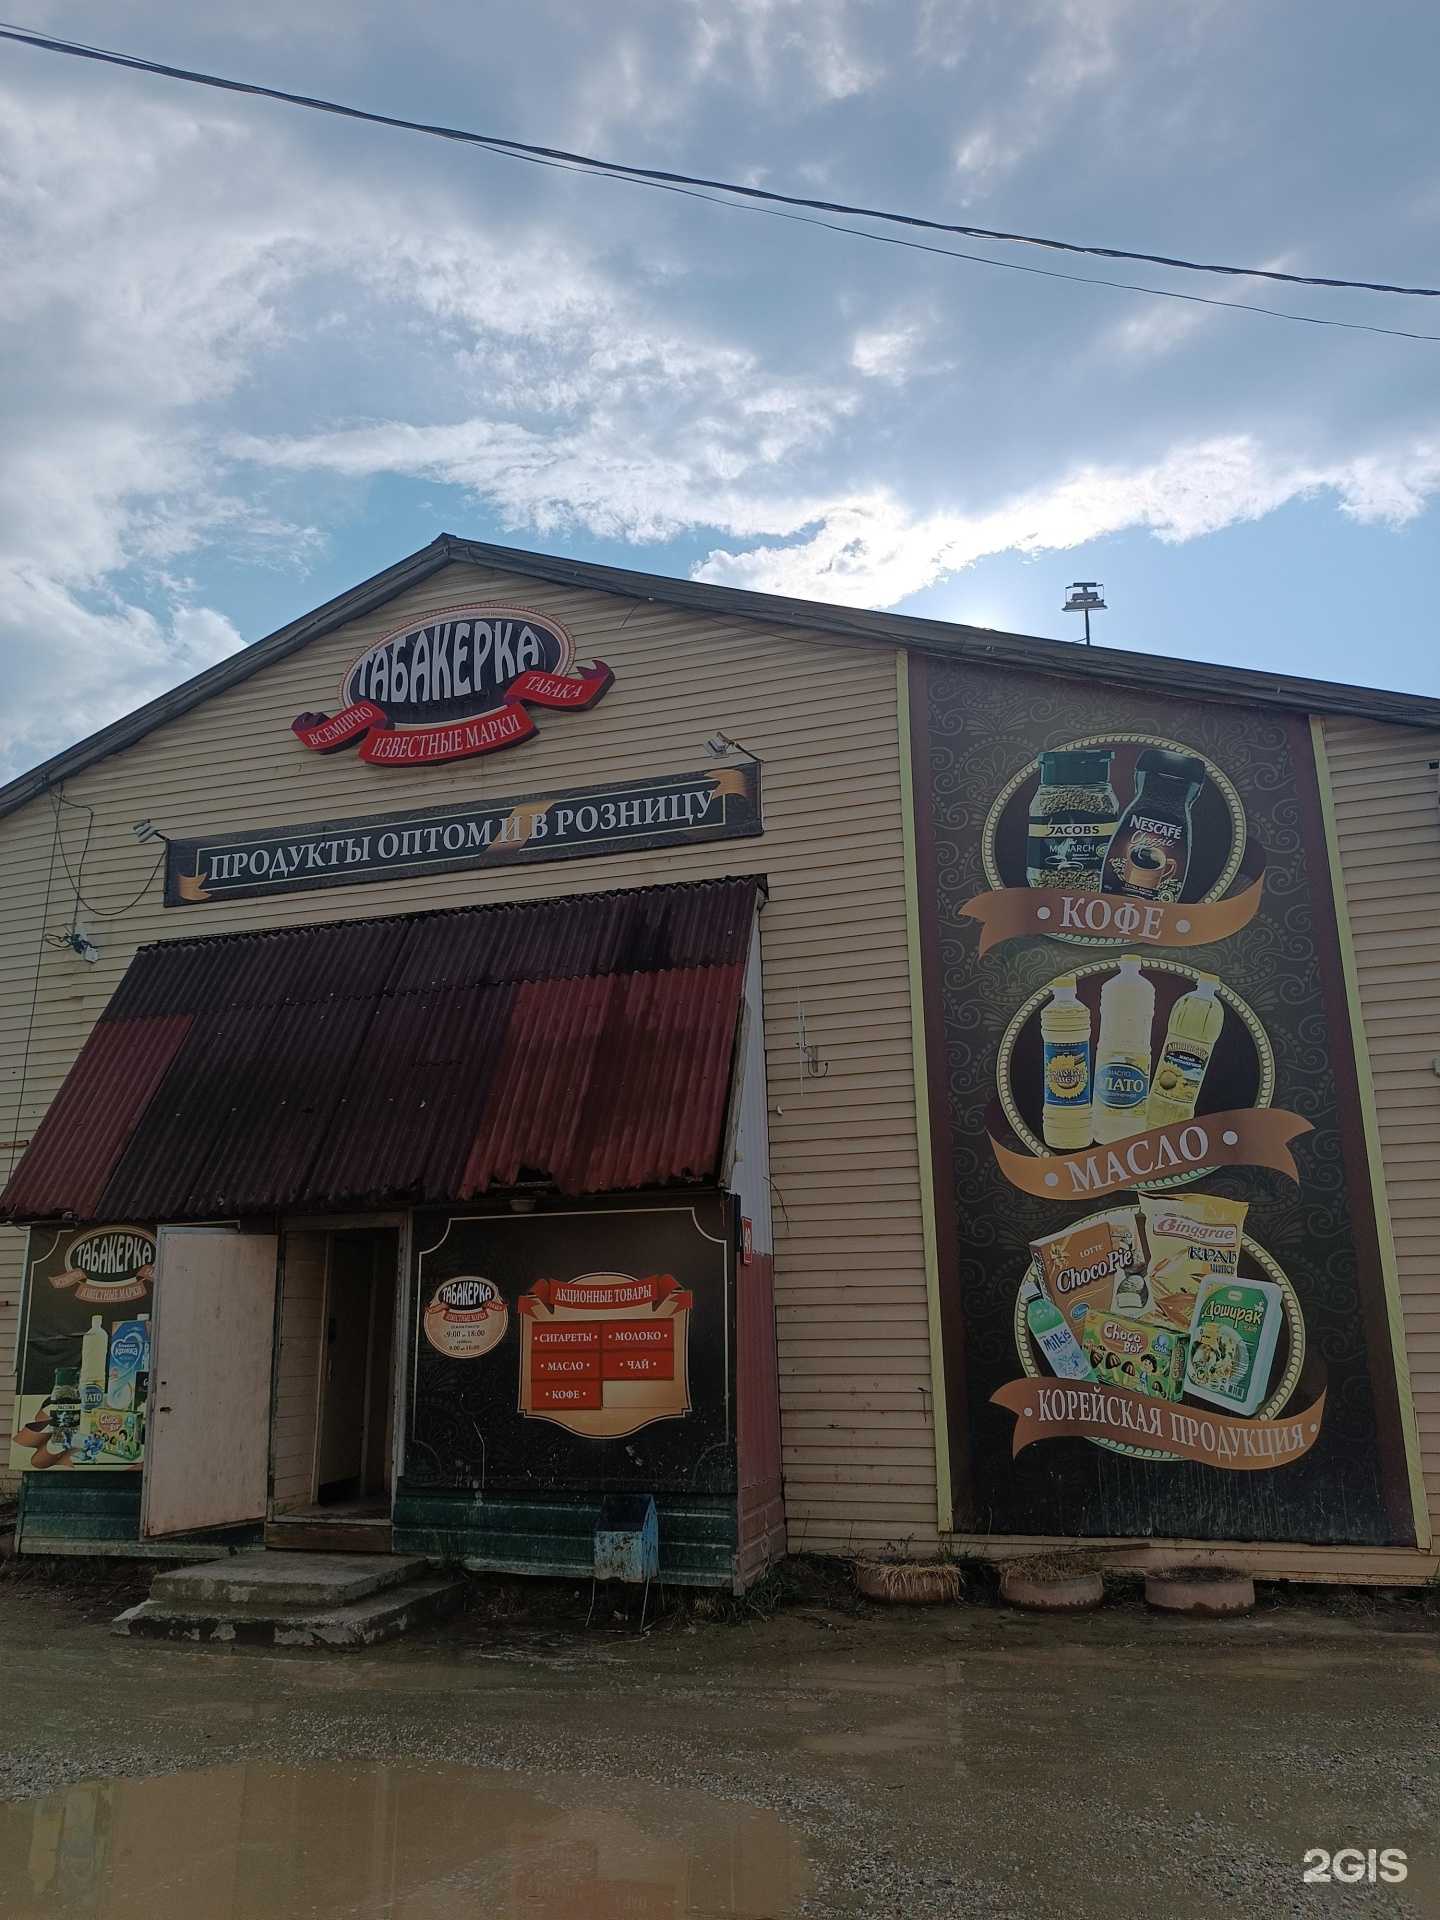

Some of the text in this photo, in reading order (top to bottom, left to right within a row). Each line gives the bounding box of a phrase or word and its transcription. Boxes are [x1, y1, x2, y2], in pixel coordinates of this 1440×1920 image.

[357, 620, 540, 703] ТАБАКЕРКА
[525, 675, 584, 700] ТАБАКА
[308, 706, 373, 746] ВСЕМИРНО
[370, 714, 522, 758] ИЗВЕСТНЫЕ МАРКИ
[208, 788, 716, 881] ПРОДУКТЫ ОПТОМ И В РОЗНИЦУ
[1046, 824, 1101, 837] JACOBS
[1129, 814, 1183, 841] NESCAFÉ
[1049, 843, 1096, 854] MARCH
[1059, 895, 1166, 940] КОФЕ
[1063, 1125, 1210, 1193] МАСЛО
[76, 1234, 152, 1274] ТАБАКЕРКА
[1079, 1244, 1104, 1258] LOTTE
[442, 1281, 492, 1306] ТАБАКЕРКА
[555, 1283, 652, 1305] АКЦИОННЫЕ ТОВАРЫ
[1201, 1300, 1263, 1329] Доширак
[539, 1332, 592, 1344] СИГАРЕТЫ
[614, 1330, 662, 1342] МОЛОКО
[1043, 1329, 1072, 1353] Milkis
[547, 1360, 584, 1372] МАСЛО
[627, 1357, 650, 1370] ЧАЙ
[551, 1389, 580, 1400] КОФЕ
[1037, 1387, 1307, 1458] КОРЕЙСКАЯ ПРОДУКЦИЯ
